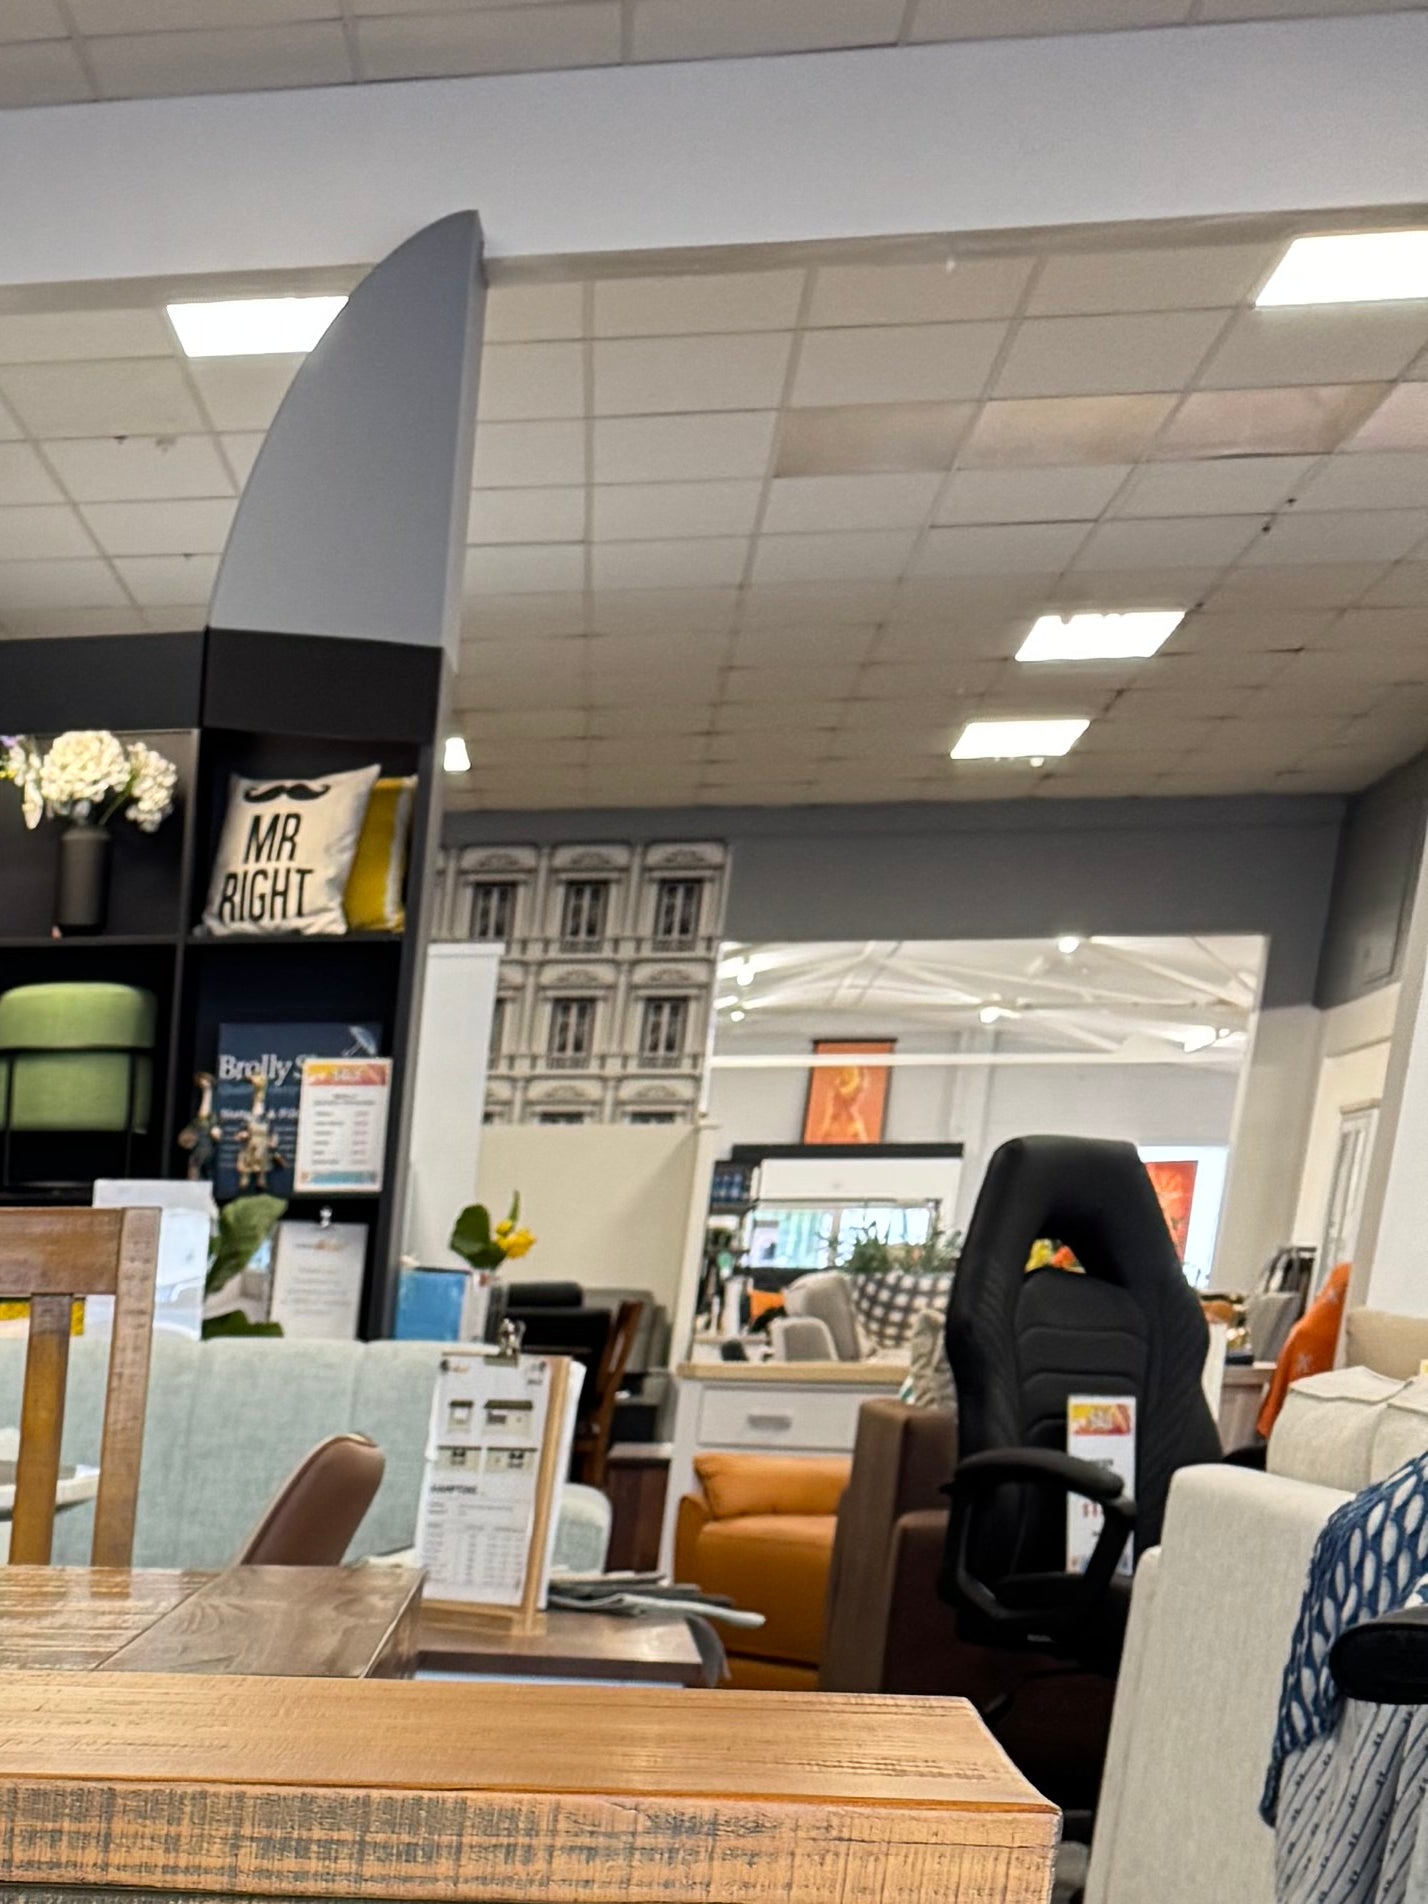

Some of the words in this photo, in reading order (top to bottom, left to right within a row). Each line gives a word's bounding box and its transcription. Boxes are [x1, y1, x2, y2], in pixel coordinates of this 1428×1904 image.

[242, 812, 302, 864] MR
[218, 866, 314, 922] RIGHT
[218, 1053, 293, 1087] Brolly
